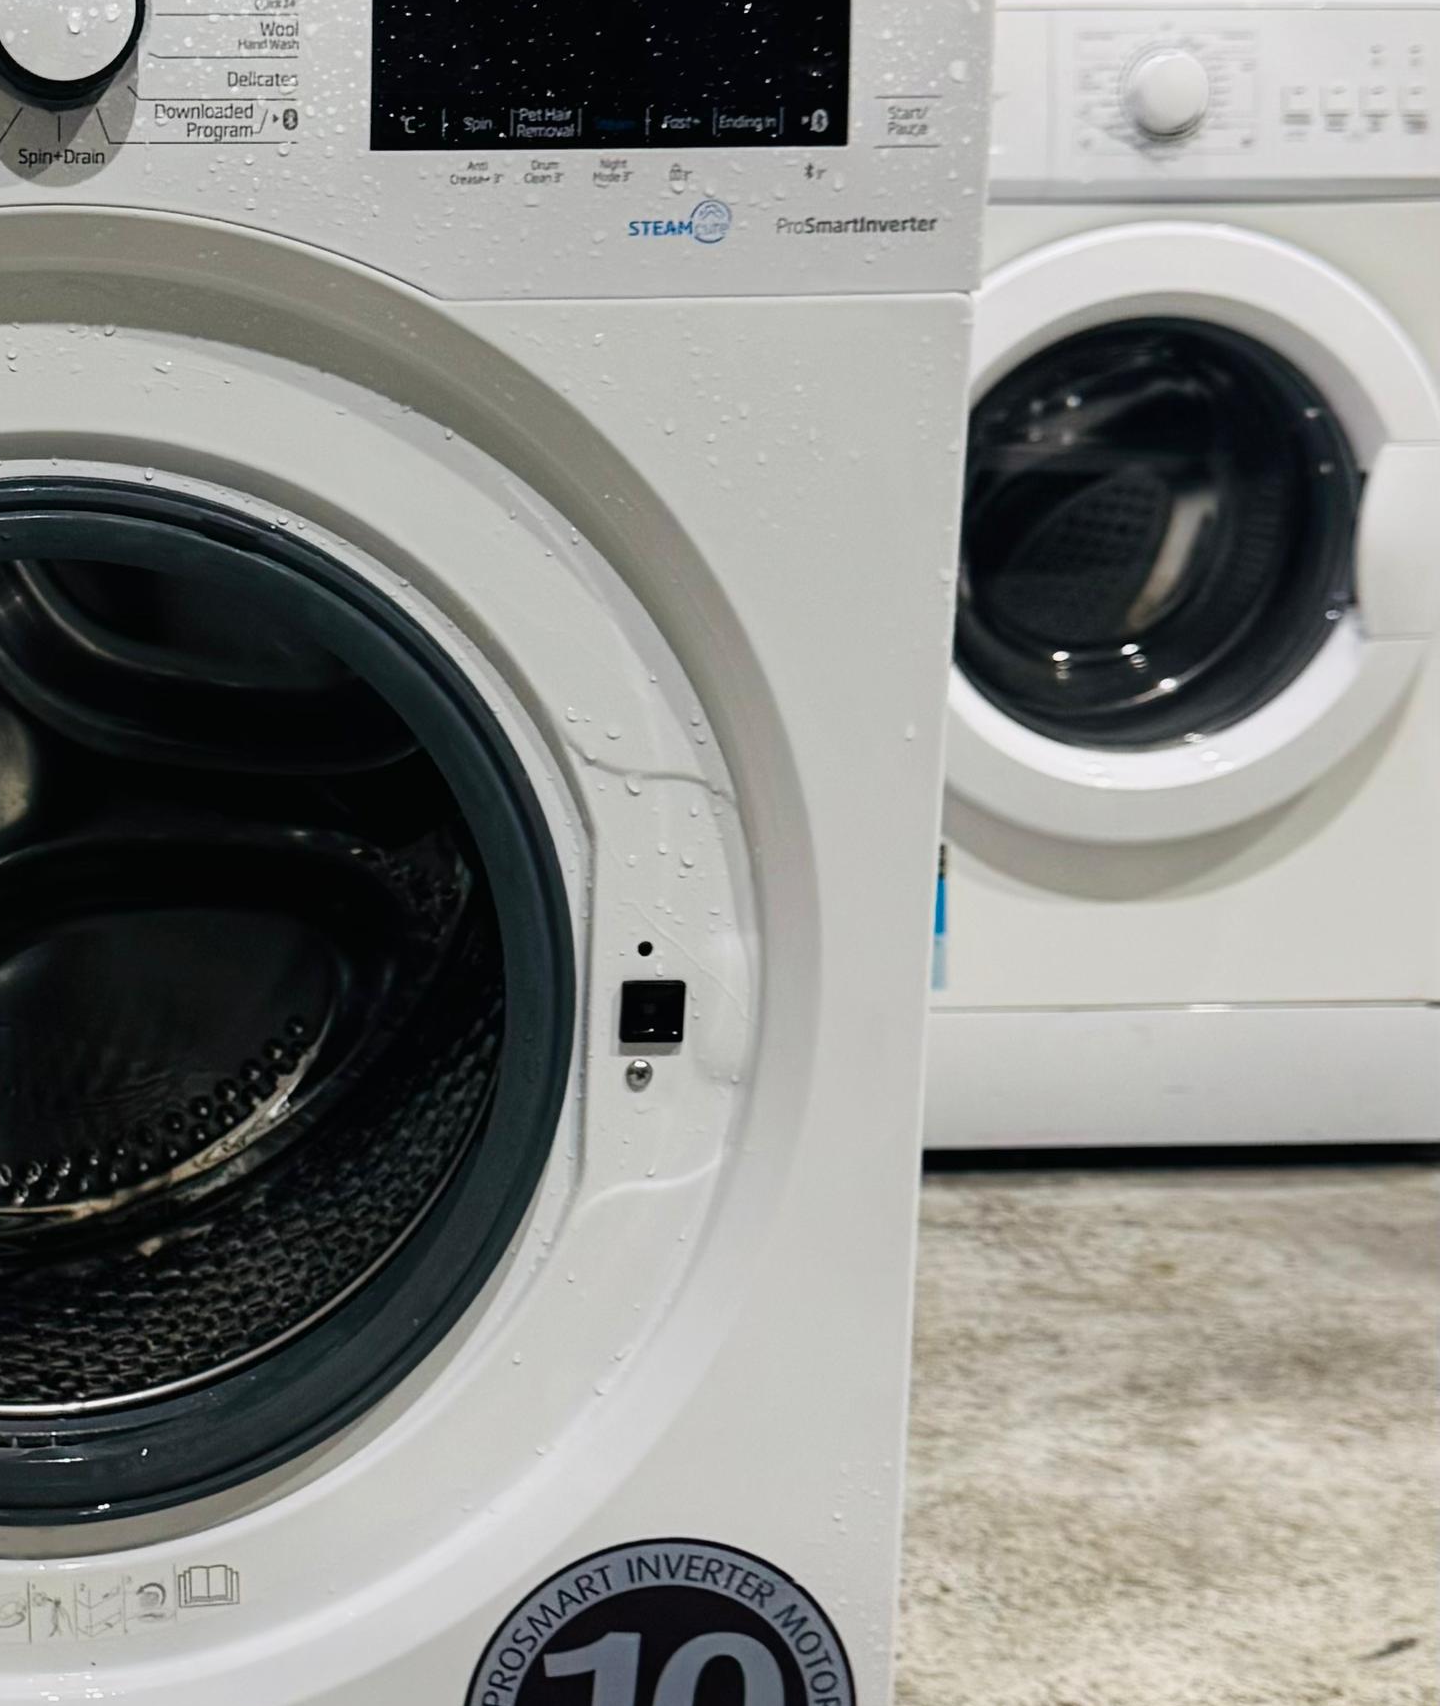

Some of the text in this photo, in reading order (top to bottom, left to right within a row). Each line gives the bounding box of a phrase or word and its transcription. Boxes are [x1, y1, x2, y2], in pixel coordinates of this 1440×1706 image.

[260, 21, 299, 37] Wool
[238, 39, 300, 50] Hand Wash
[228, 71, 298, 87] Delicates
[154, 103, 254, 119] Downloaded
[519, 108, 572, 121] Pet Hair
[463, 117, 493, 134] Spin
[516, 124, 575, 138] Removal
[718, 115, 763, 132] Ending
[887, 121, 928, 136] Pause
[187, 122, 253, 142] Program
[18, 148, 105, 168] Spin+Drain
[531, 160, 560, 171] Drum
[600, 159, 628, 172] Night
[524, 173, 554, 184] Clean
[592, 172, 620, 183] Mode
[628, 220, 693, 237] STEAM
[776, 217, 938, 235] ProSmartInverter
[626, 1553, 776, 1609] INVERTER
